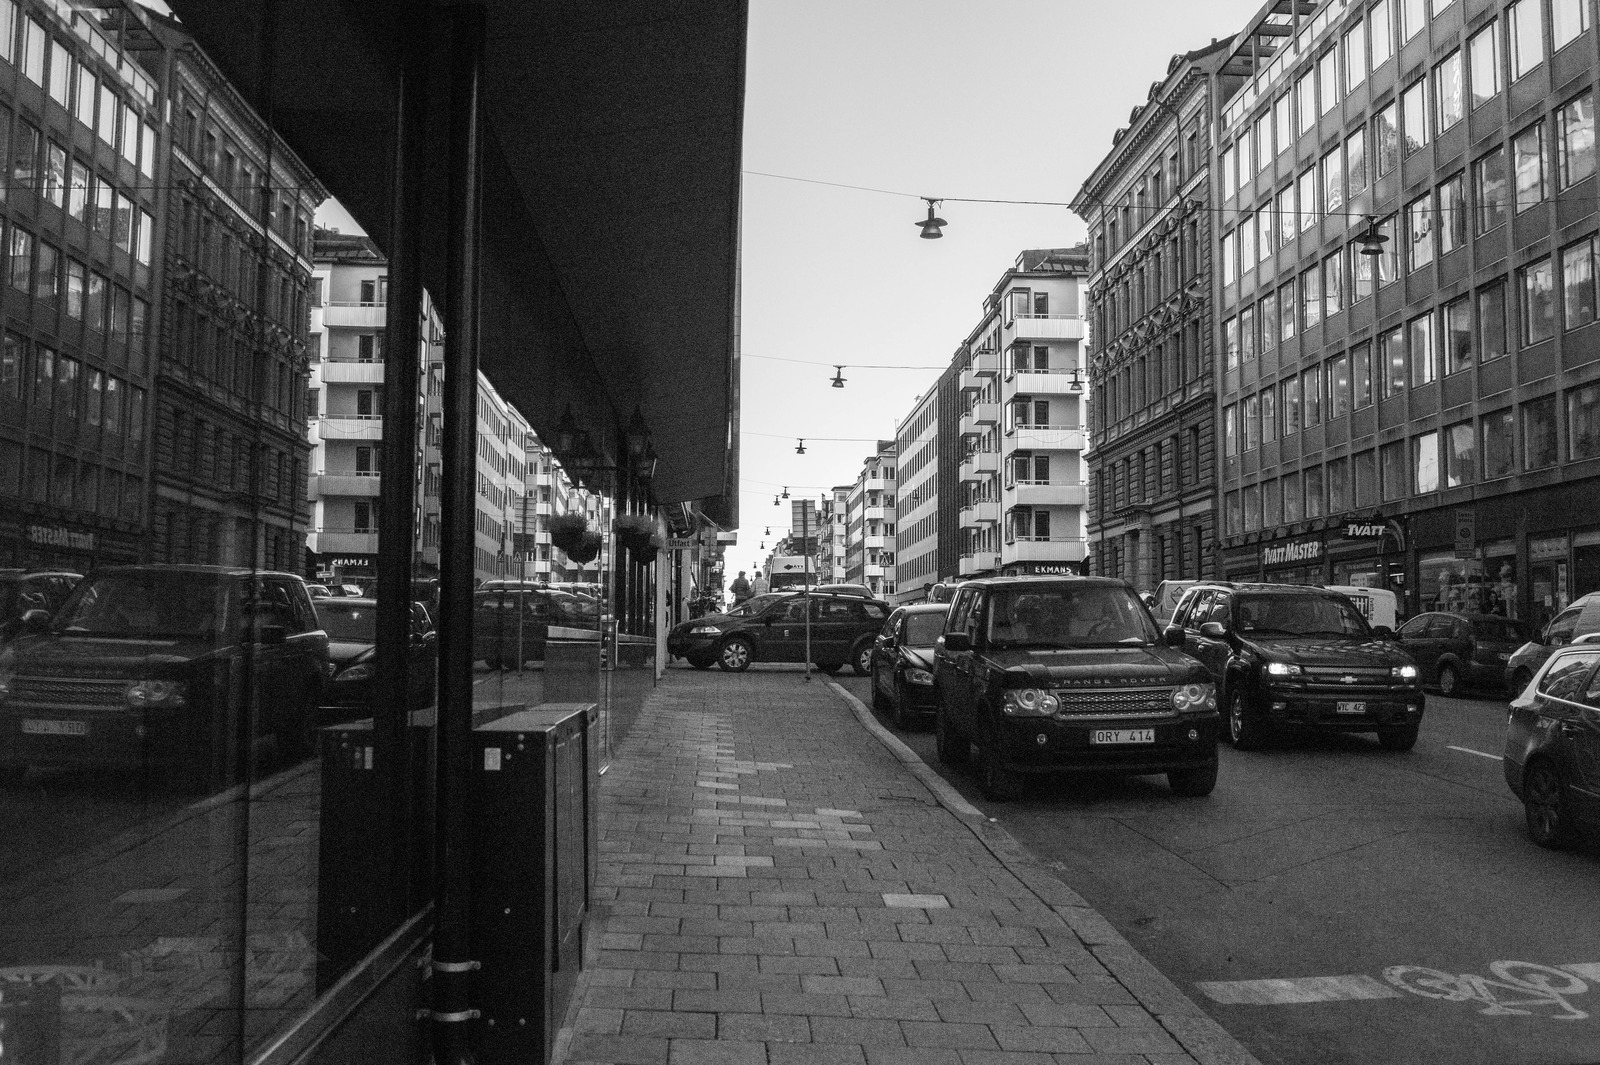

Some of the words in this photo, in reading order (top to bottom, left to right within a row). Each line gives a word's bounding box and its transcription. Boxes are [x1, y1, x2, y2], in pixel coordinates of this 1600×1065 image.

[1347, 523, 1386, 536] TVÄTT
[1264, 544, 1286, 565] TVÄTT
[1285, 540, 1319, 562] MÄSTER
[1035, 565, 1072, 574] EKMANS
[1097, 731, 1120, 742] ORY
[1129, 731, 1152, 741] 414
